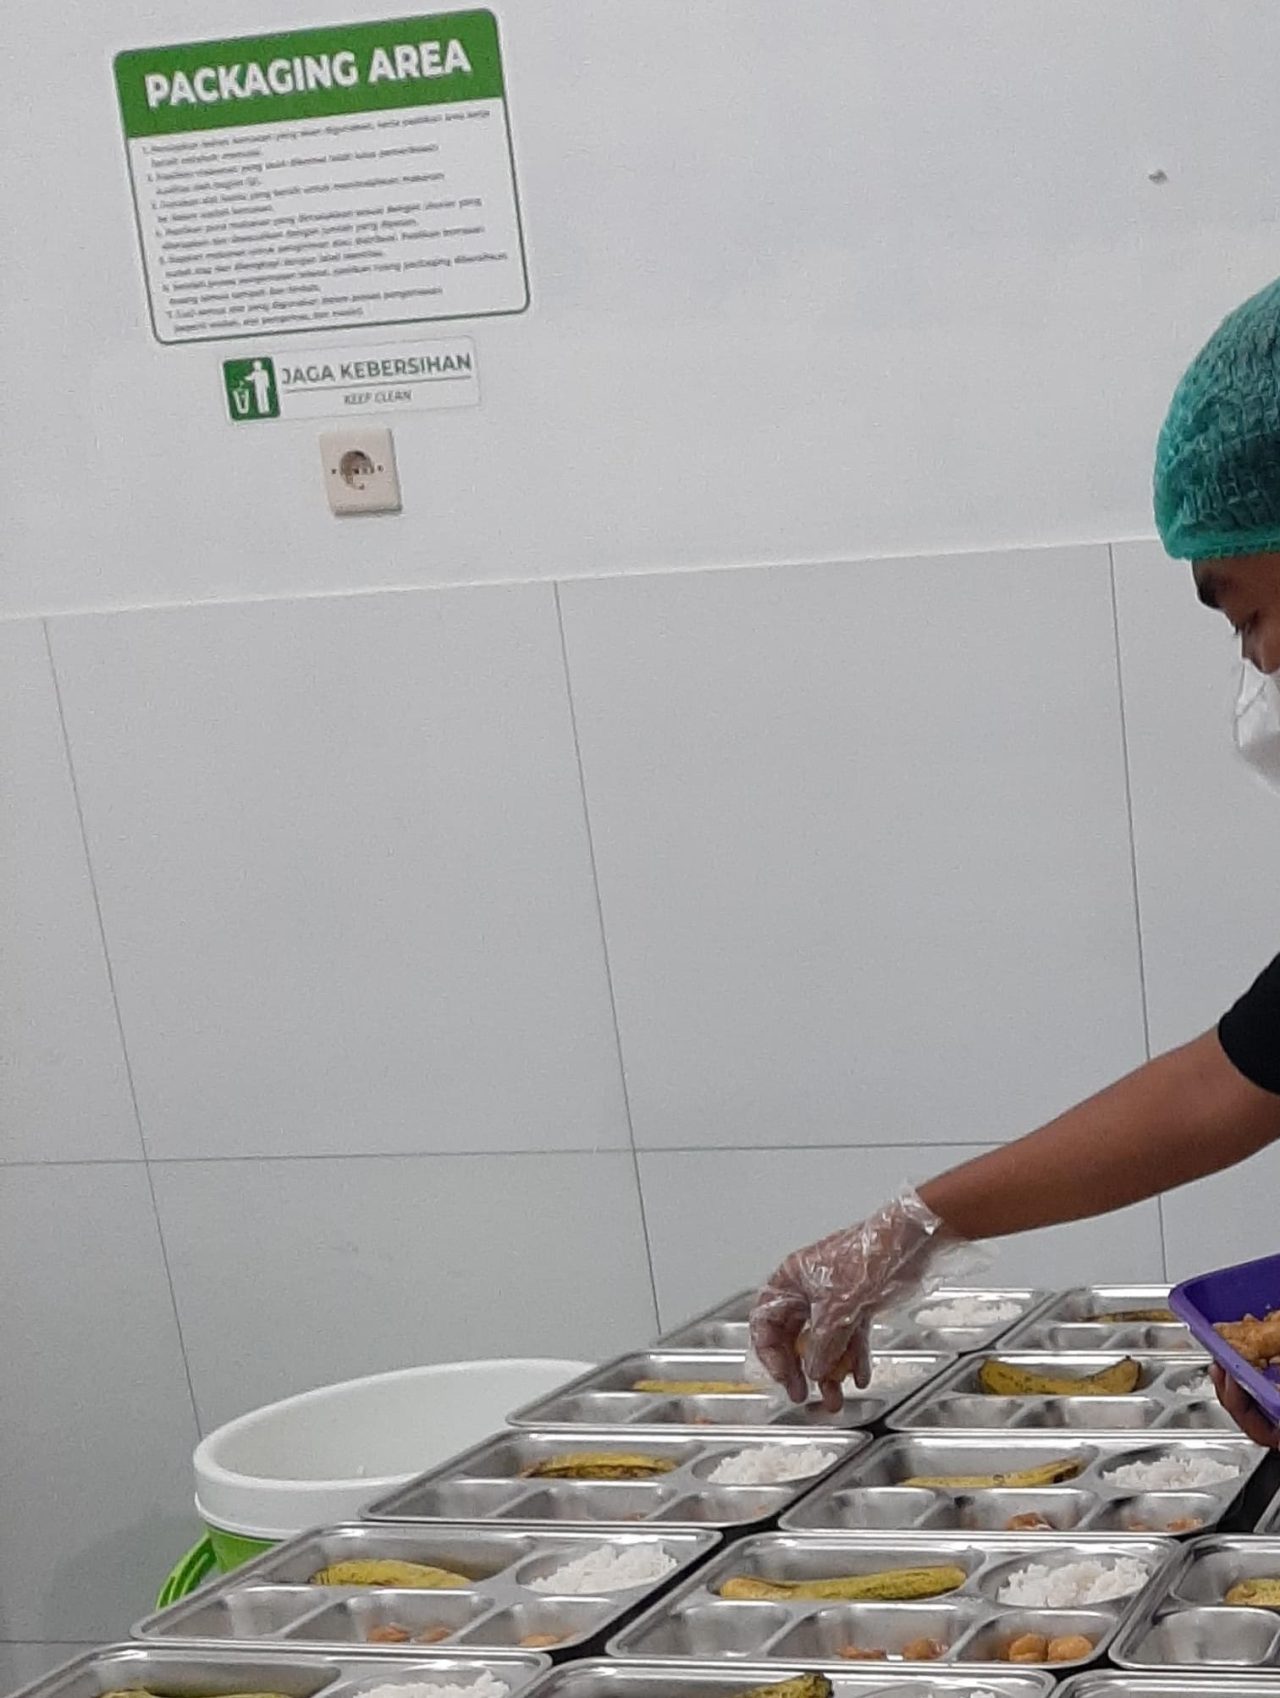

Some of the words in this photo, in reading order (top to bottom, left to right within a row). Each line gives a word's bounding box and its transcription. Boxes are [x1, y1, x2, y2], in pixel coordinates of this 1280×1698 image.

[144, 51, 358, 109] PACKAGING
[368, 39, 472, 83] AREA
[281, 364, 337, 385] JAGA
[340, 353, 471, 380] KEBERSIHAN
[344, 392, 372, 405] KEEP
[374, 389, 412, 402] CLEAN
